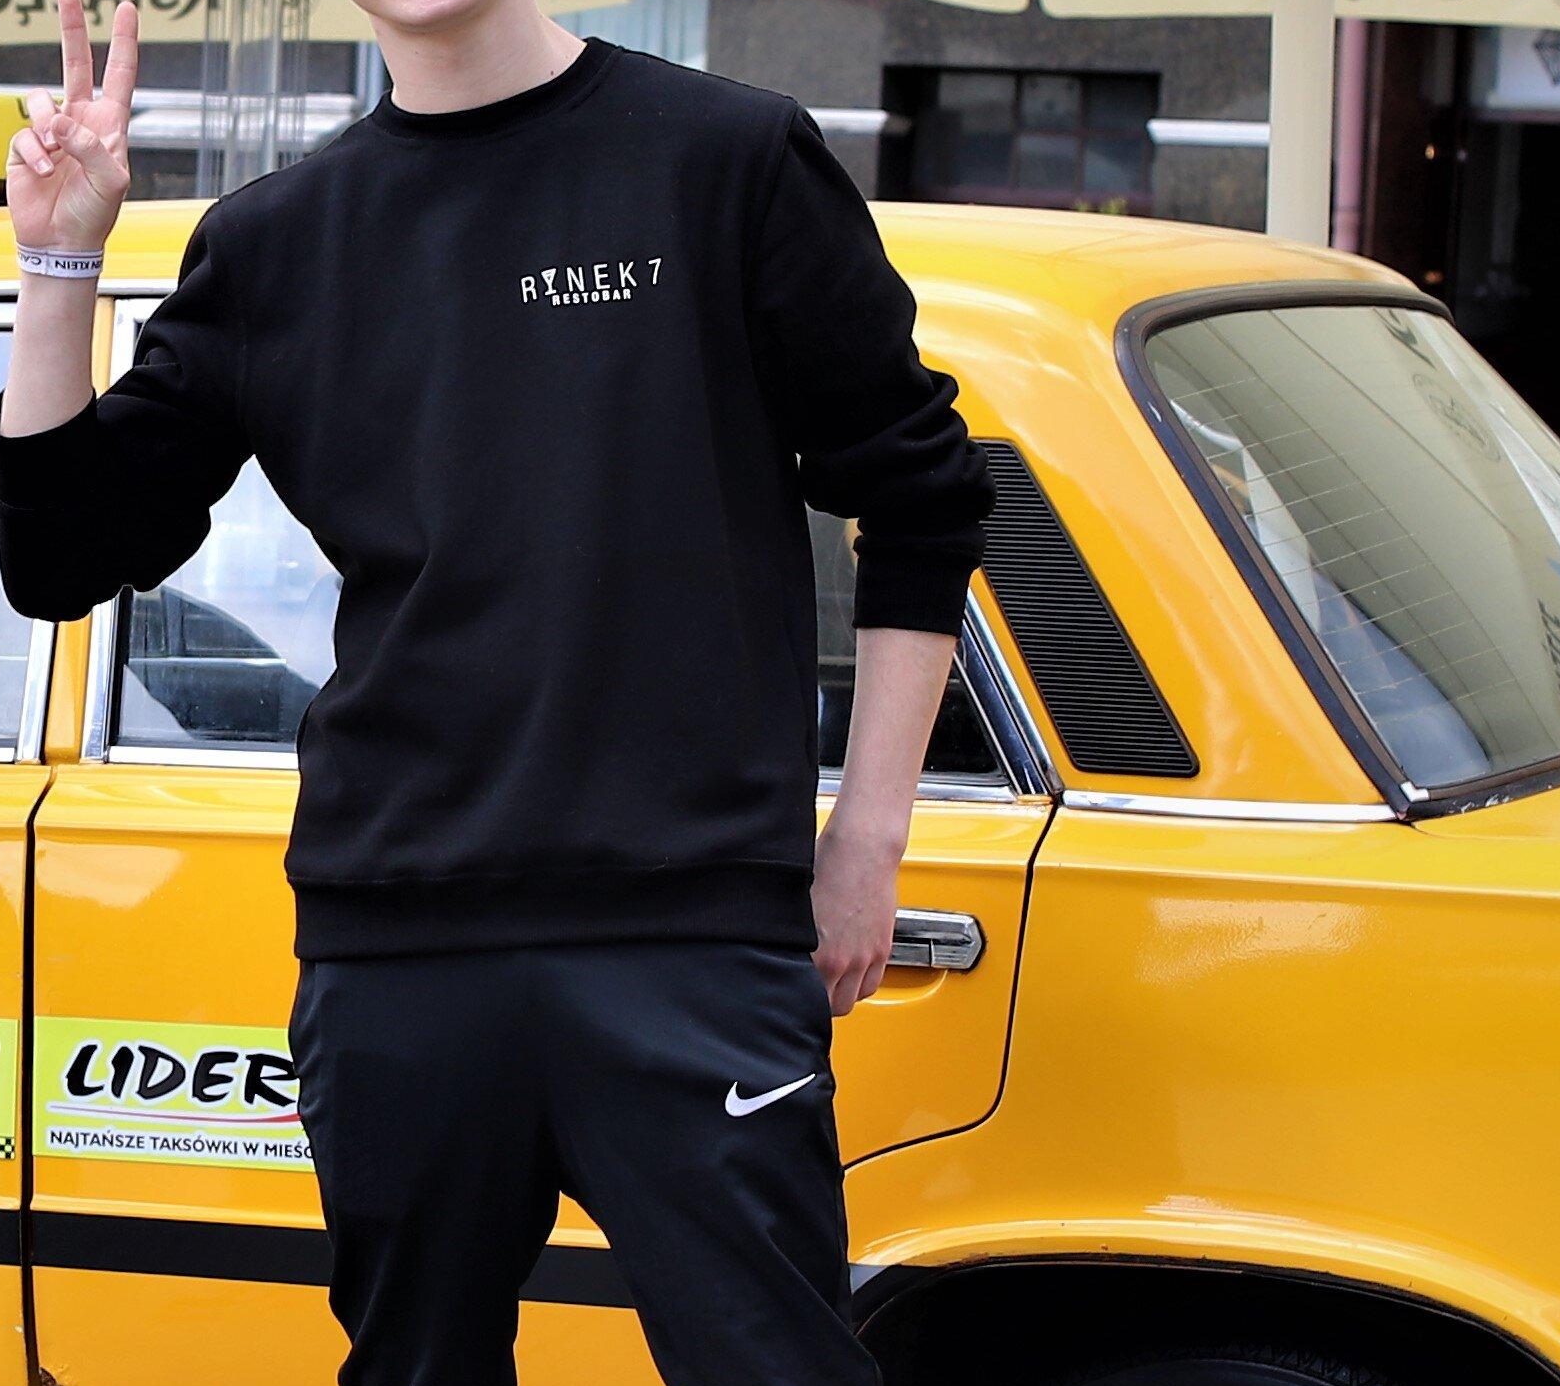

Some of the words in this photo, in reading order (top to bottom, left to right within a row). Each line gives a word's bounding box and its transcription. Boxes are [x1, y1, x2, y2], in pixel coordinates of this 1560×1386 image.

[521, 261, 637, 303] RYNEK
[648, 258, 662, 284] 7
[552, 288, 631, 306] RESTOBAR
[67, 1039, 300, 1108] LIDER
[50, 1130, 145, 1149] NAJTAŃSZE
[151, 1135, 238, 1155] TAKSÓWKI
[242, 1141, 259, 1156] W
